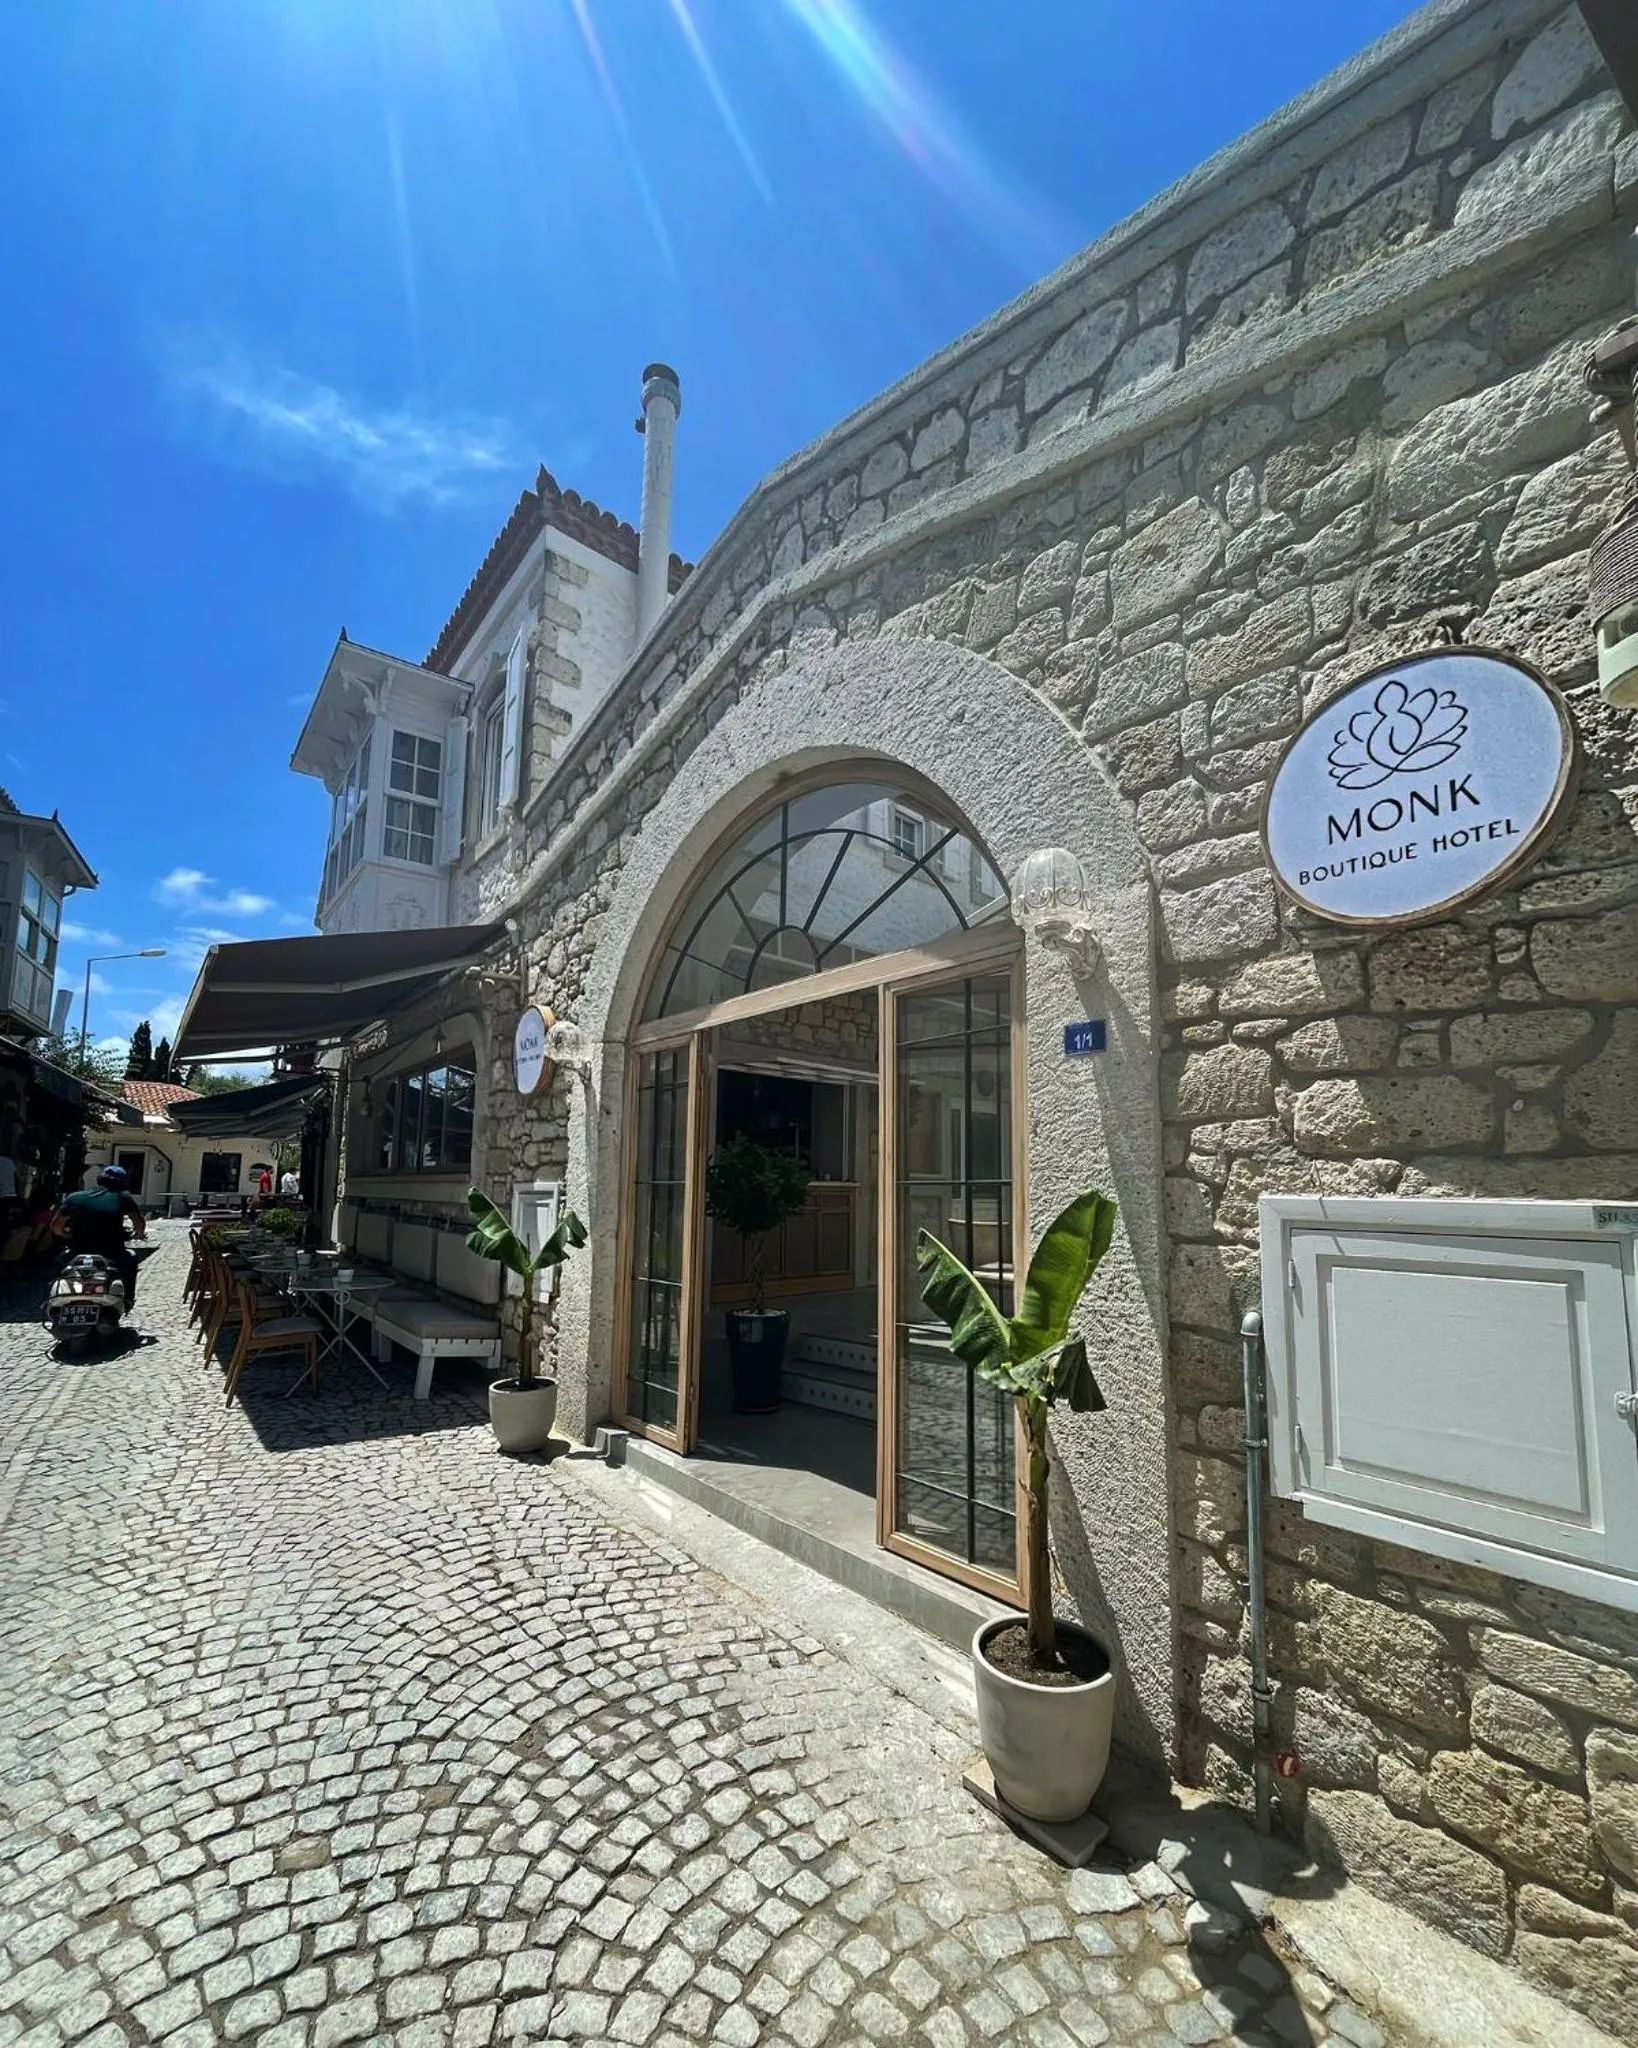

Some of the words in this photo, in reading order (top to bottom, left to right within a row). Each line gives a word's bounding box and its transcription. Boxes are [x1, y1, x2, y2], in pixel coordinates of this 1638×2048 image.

[1328, 773, 1480, 845] MONK
[1299, 843, 1418, 885] BOUTIQUE
[1433, 818, 1520, 853] HOTEL
